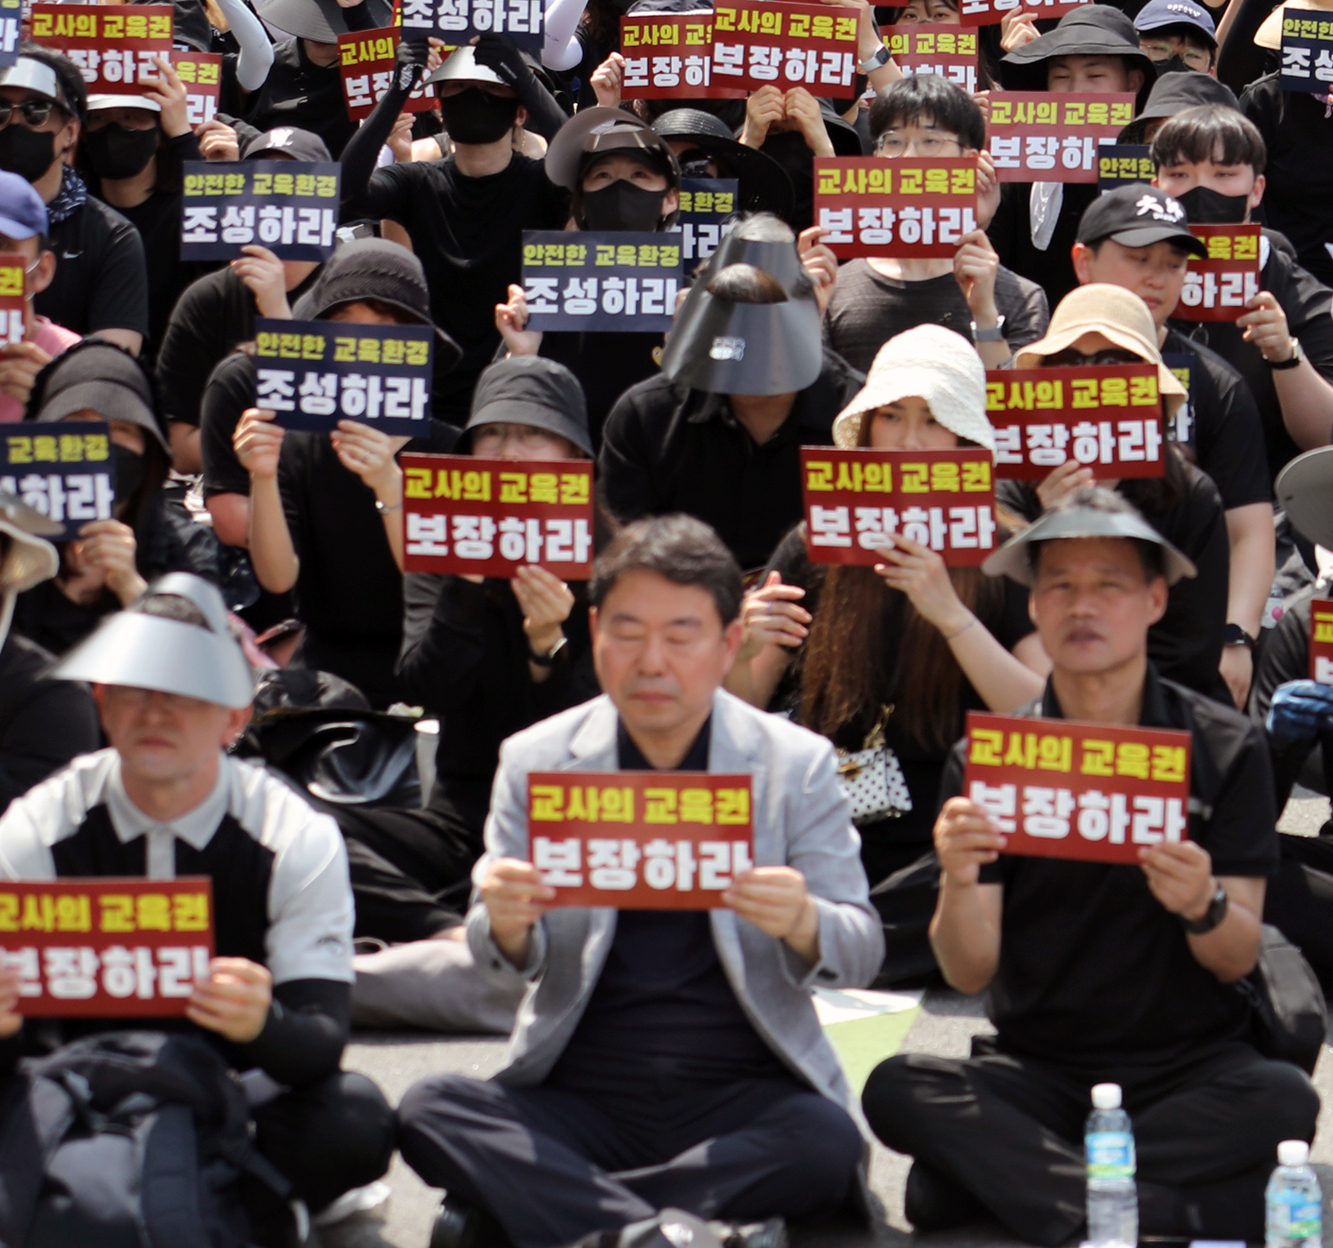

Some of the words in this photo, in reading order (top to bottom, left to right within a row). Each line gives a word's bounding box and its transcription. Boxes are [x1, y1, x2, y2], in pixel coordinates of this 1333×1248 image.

[715, 8, 782, 35] 교사의
[788, 14, 857, 40] 교육권
[713, 43, 855, 86] 보장하라
[184, 174, 245, 195] 안전한
[253, 174, 336, 197] 교육환경
[818, 169, 892, 194] 교사의
[900, 169, 974, 194] 교육권
[183, 207, 336, 246] 조성하라
[817, 207, 979, 244] 보장하라
[523, 245, 587, 266] 안전한
[595, 245, 679, 266] 교육환경
[523, 277, 678, 315] 조성하라
[257, 333, 325, 359] 안전한
[334, 338, 428, 365] 교육환경
[254, 370, 428, 419] 조성하라
[405, 468, 491, 501] 교사의
[500, 473, 589, 504] 교육권
[806, 462, 892, 492] 교사의
[901, 462, 991, 493] 교육권
[407, 513, 591, 563] 보장하라
[811, 506, 995, 552] 보장하라
[532, 786, 634, 823] 교사의
[644, 789, 749, 824] 교육권
[532, 835, 754, 894] 보장하라
